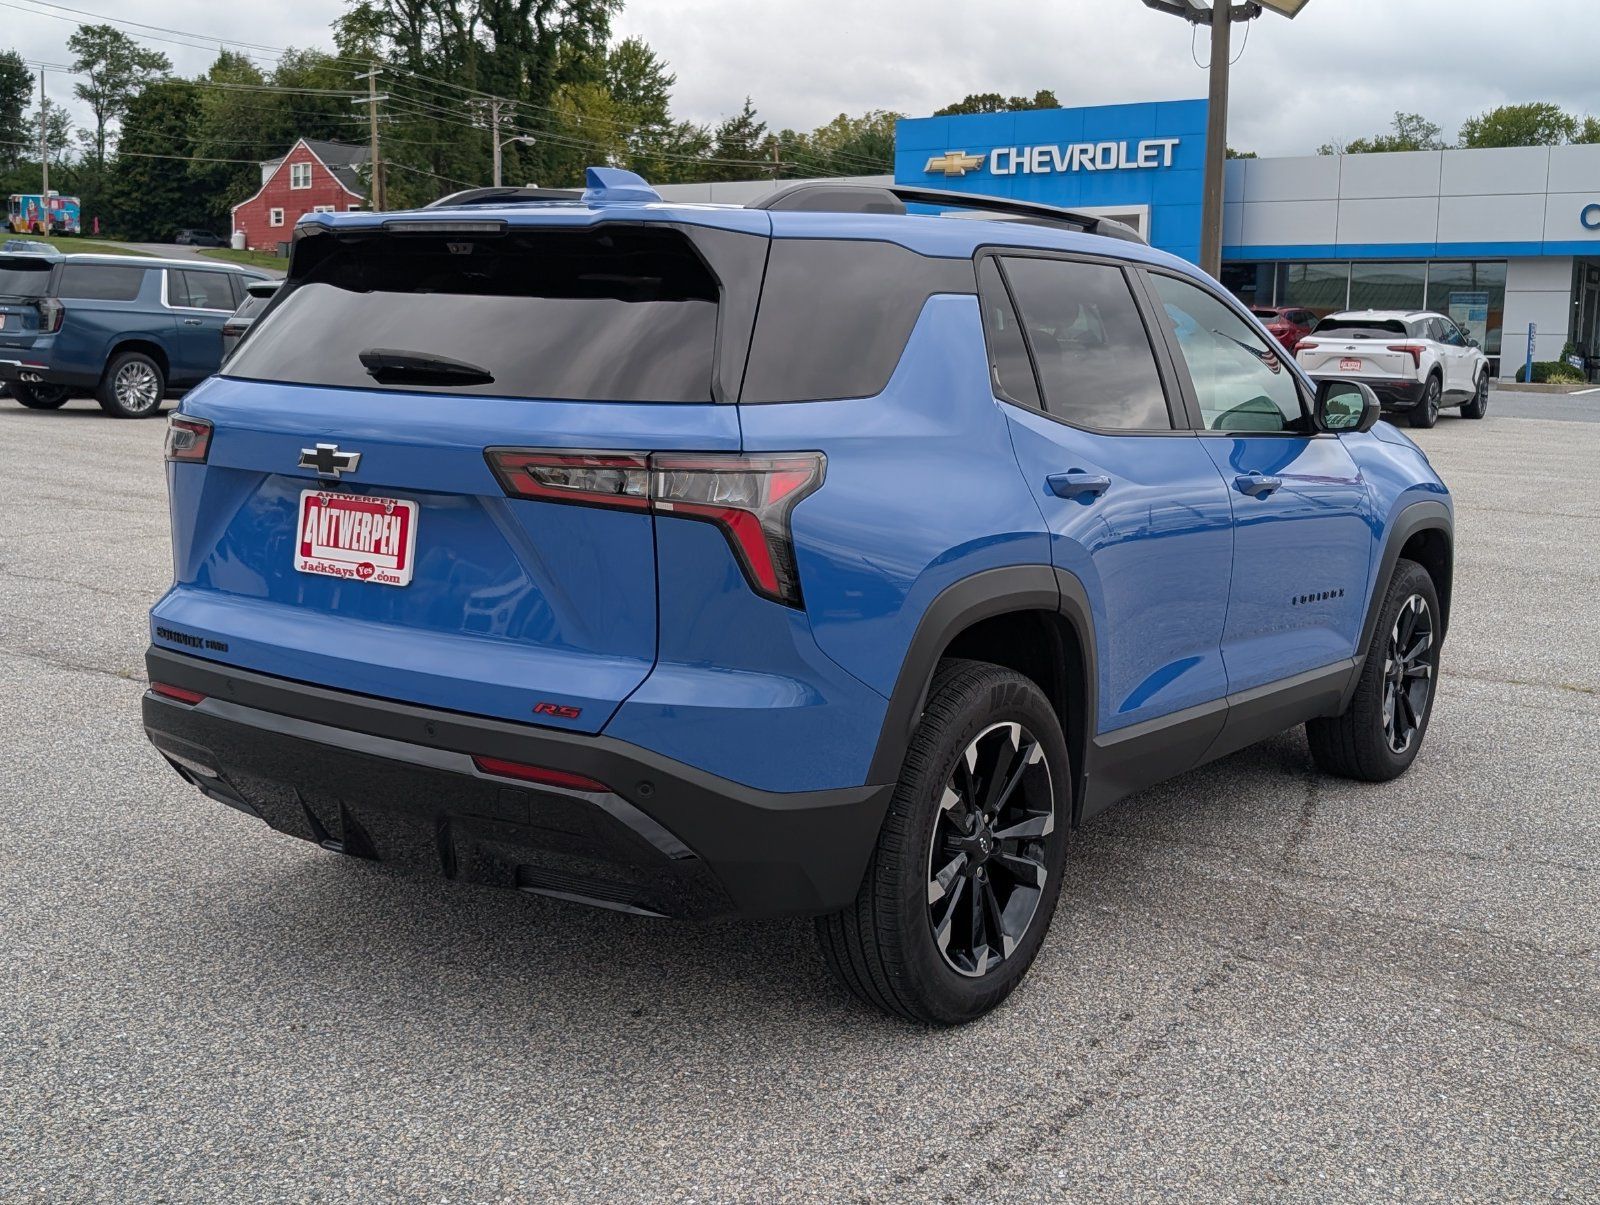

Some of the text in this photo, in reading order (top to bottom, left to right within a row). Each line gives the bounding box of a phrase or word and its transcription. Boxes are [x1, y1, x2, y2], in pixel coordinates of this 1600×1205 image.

[990, 138, 1180, 175] CHEVROLET
[315, 492, 399, 505] ANTWERPEN
[304, 506, 402, 556] ANTWERPEN
[1291, 588, 1345, 606] EQUINOX
[157, 627, 204, 649] EQUINOX
[532, 702, 584, 719] RS
